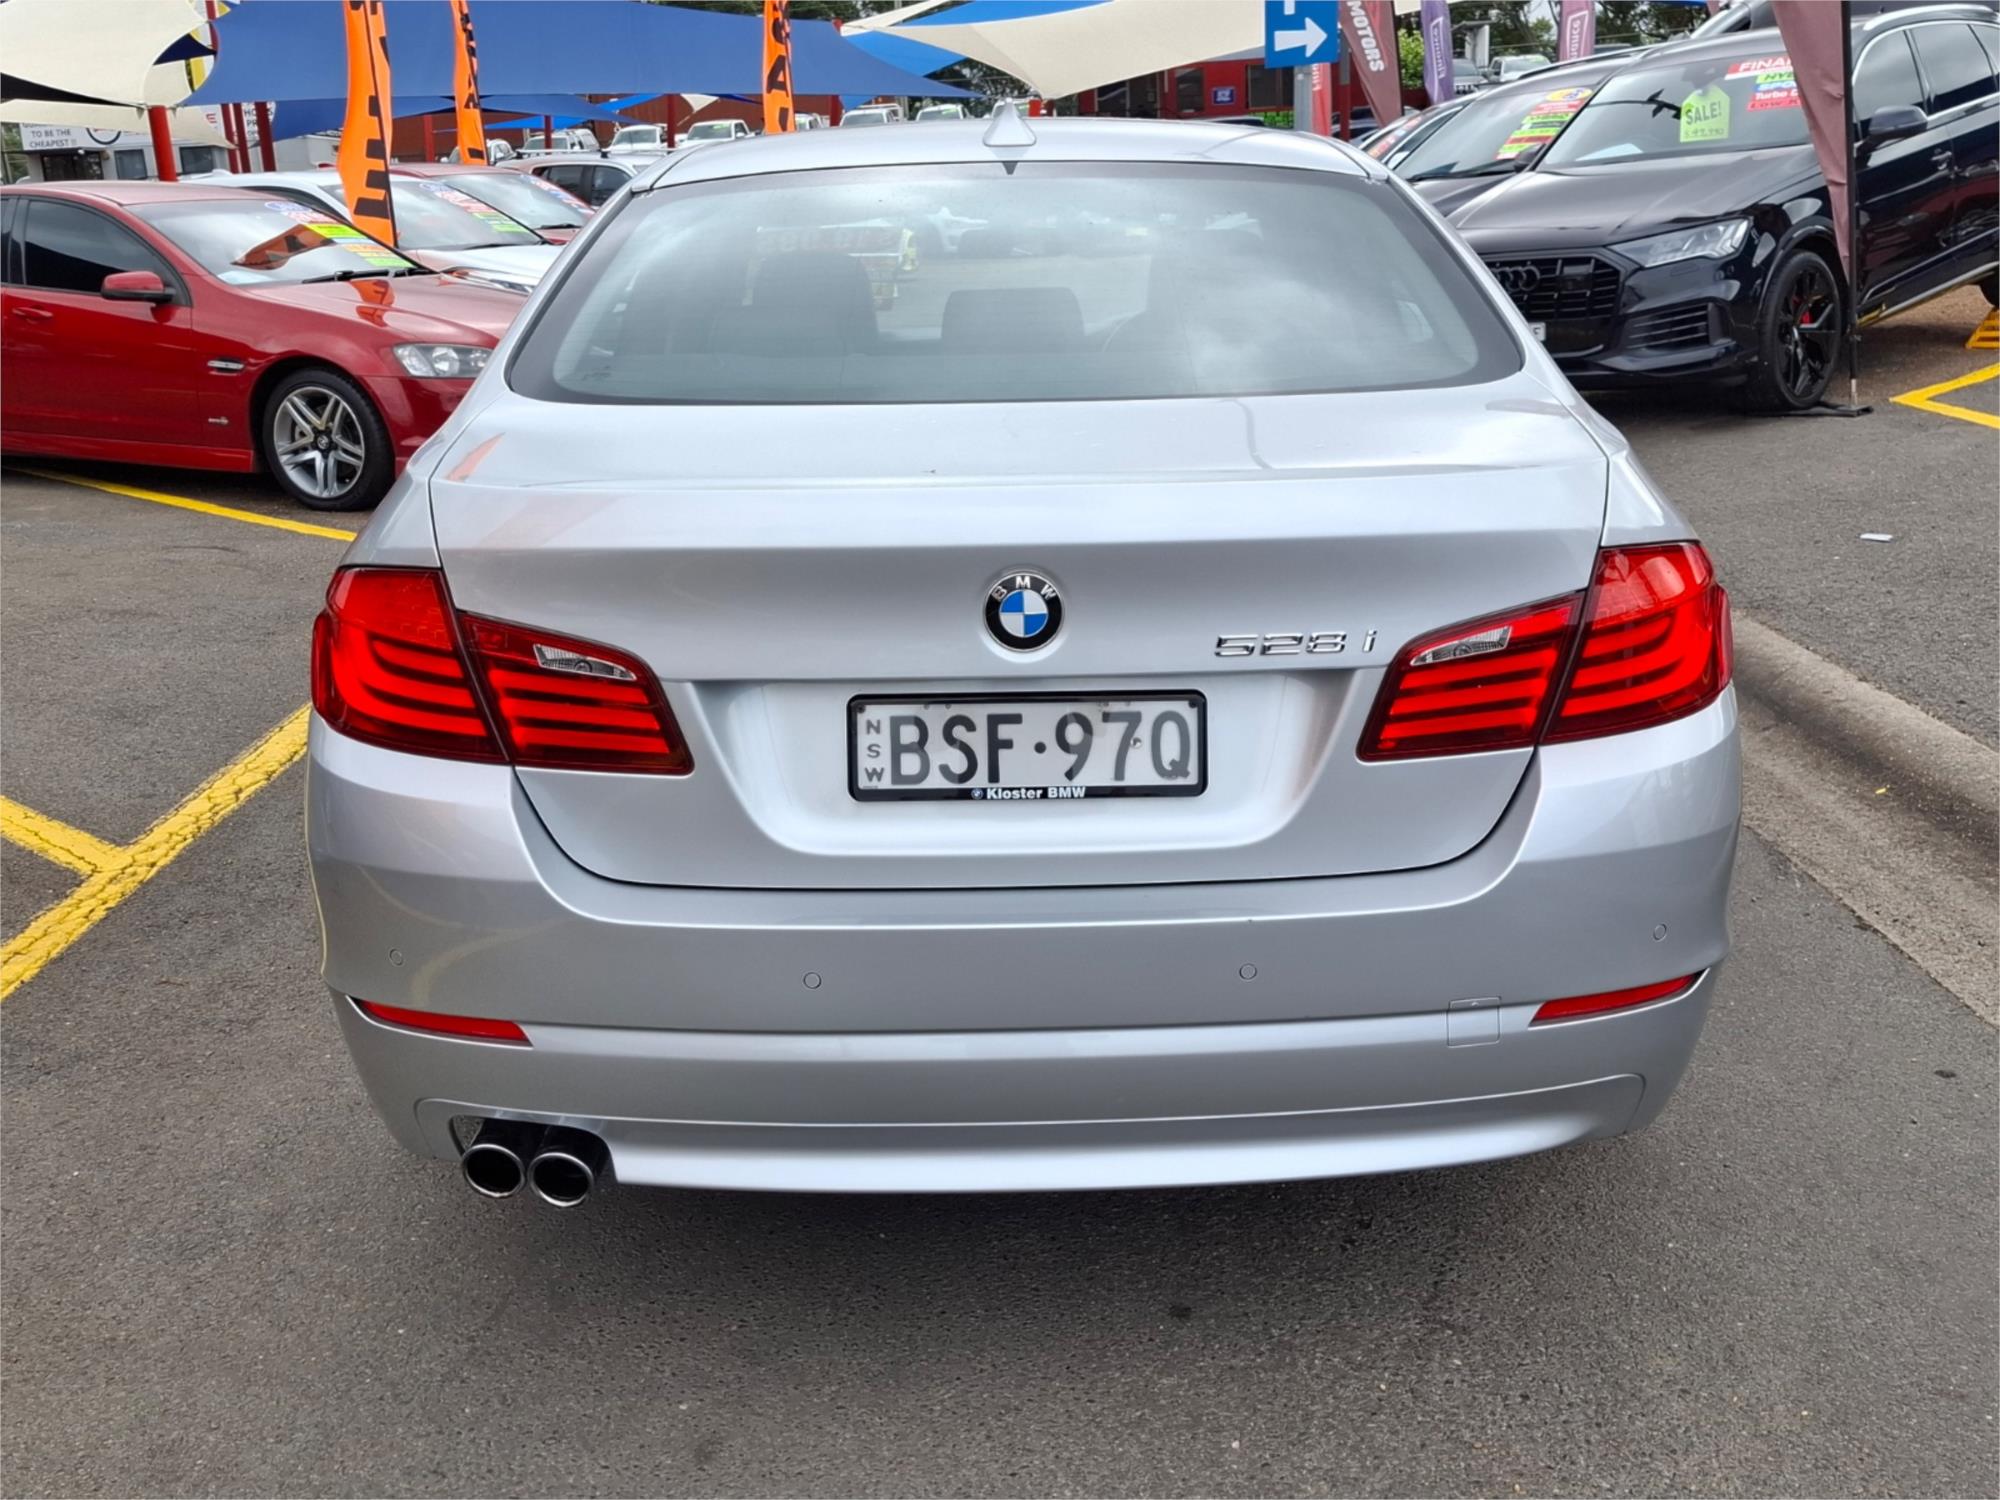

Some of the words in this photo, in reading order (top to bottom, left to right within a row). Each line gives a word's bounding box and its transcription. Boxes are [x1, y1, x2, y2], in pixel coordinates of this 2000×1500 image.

[1347, 0, 1385, 72] MOTORS
[1738, 57, 1792, 73] FINA
[1755, 90, 1788, 100] Turbo
[1685, 100, 1723, 125] SALE!
[31, 130, 43, 138] TO
[44, 129, 54, 137] BE
[56, 128, 72, 136] THE
[29, 139, 69, 148] CHEAPEST
[991, 575, 1057, 602] BMW
[986, 787, 1043, 800] Kloster
[1047, 786, 1086, 799] BMW
